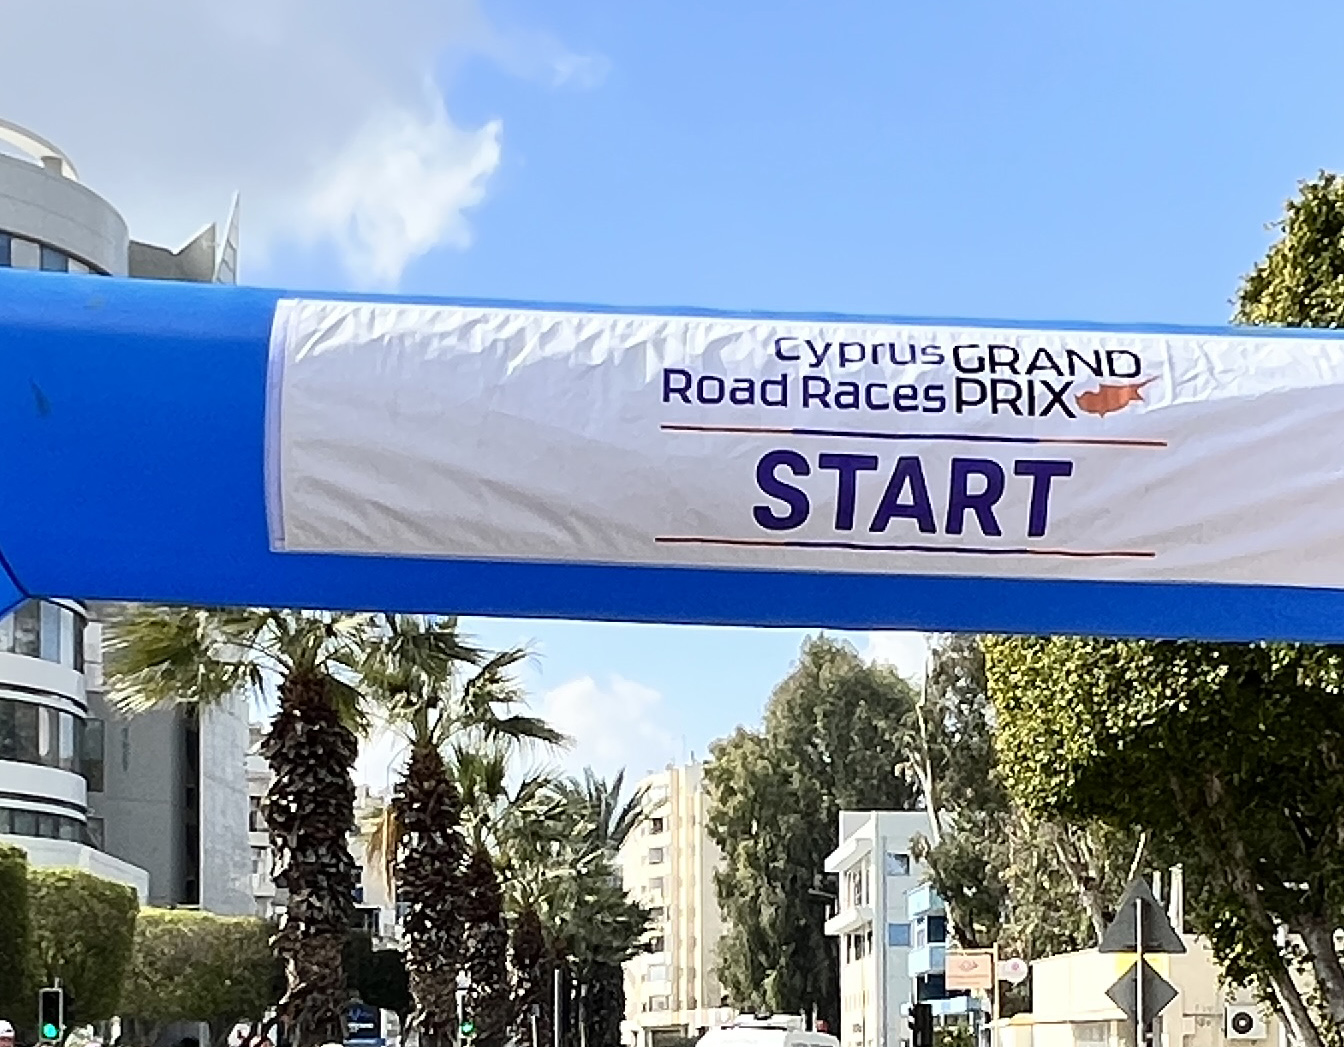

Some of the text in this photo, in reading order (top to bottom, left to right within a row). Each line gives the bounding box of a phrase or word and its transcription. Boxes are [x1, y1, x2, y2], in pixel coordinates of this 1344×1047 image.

[773, 336, 1142, 379] Cyprus GRAND
[661, 367, 1077, 418] Road Races PRIX
[752, 449, 1073, 537] START
